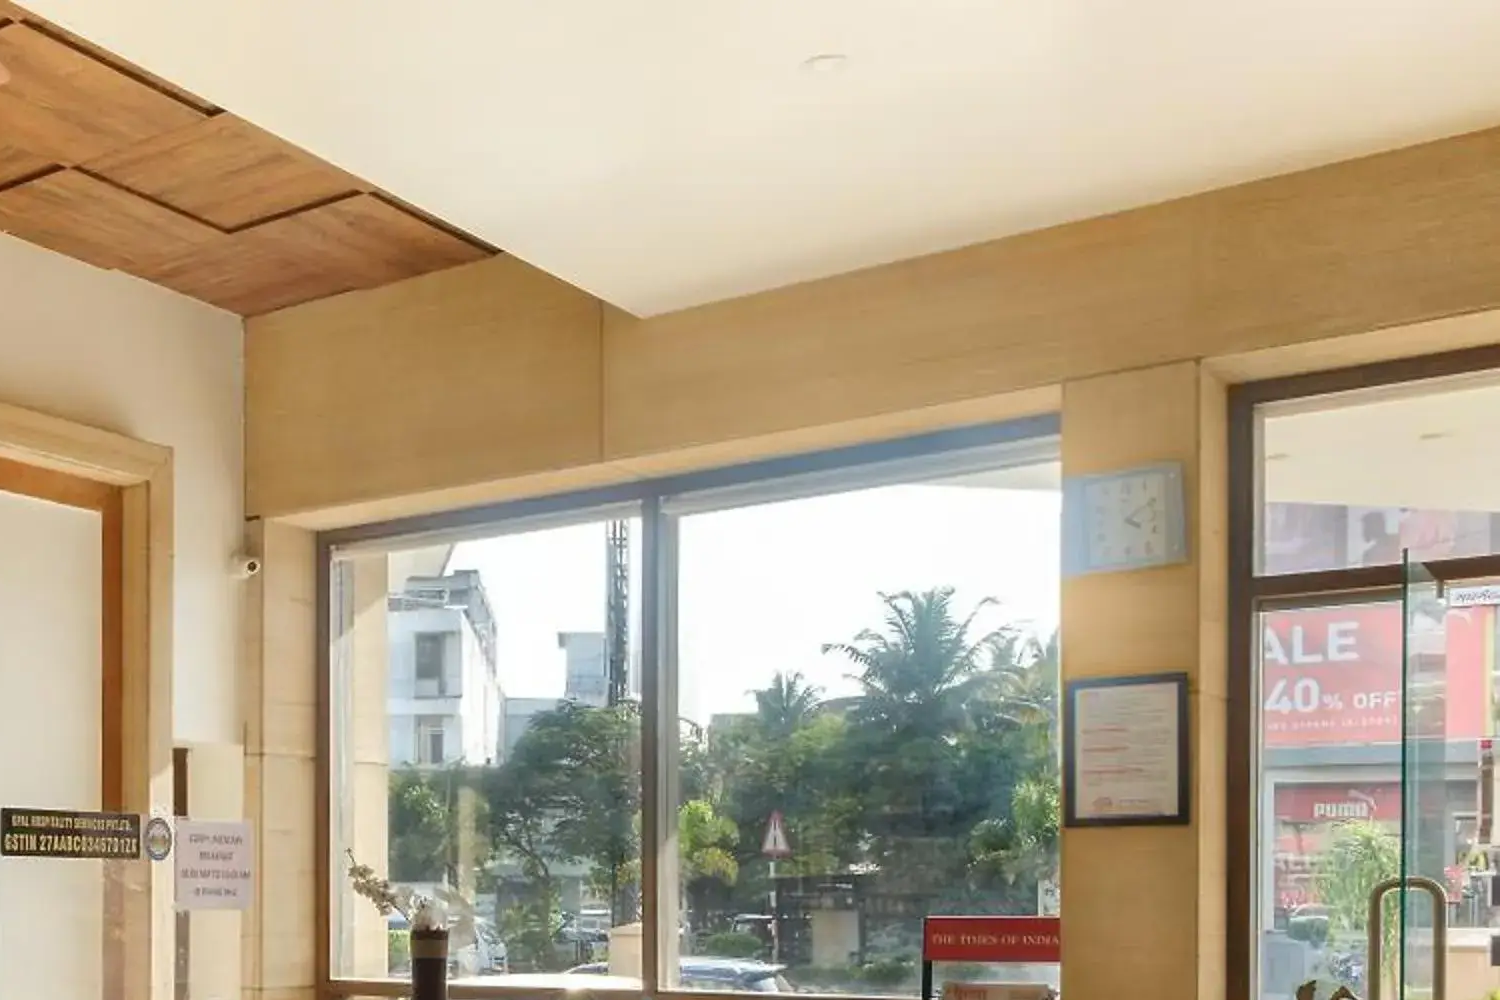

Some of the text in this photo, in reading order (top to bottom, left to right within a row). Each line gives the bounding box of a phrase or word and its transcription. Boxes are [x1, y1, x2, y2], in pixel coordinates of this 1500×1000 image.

[1353, 690, 1397, 709] OFF
[932, 933, 1059, 945] THE TIMES OF INDIA
